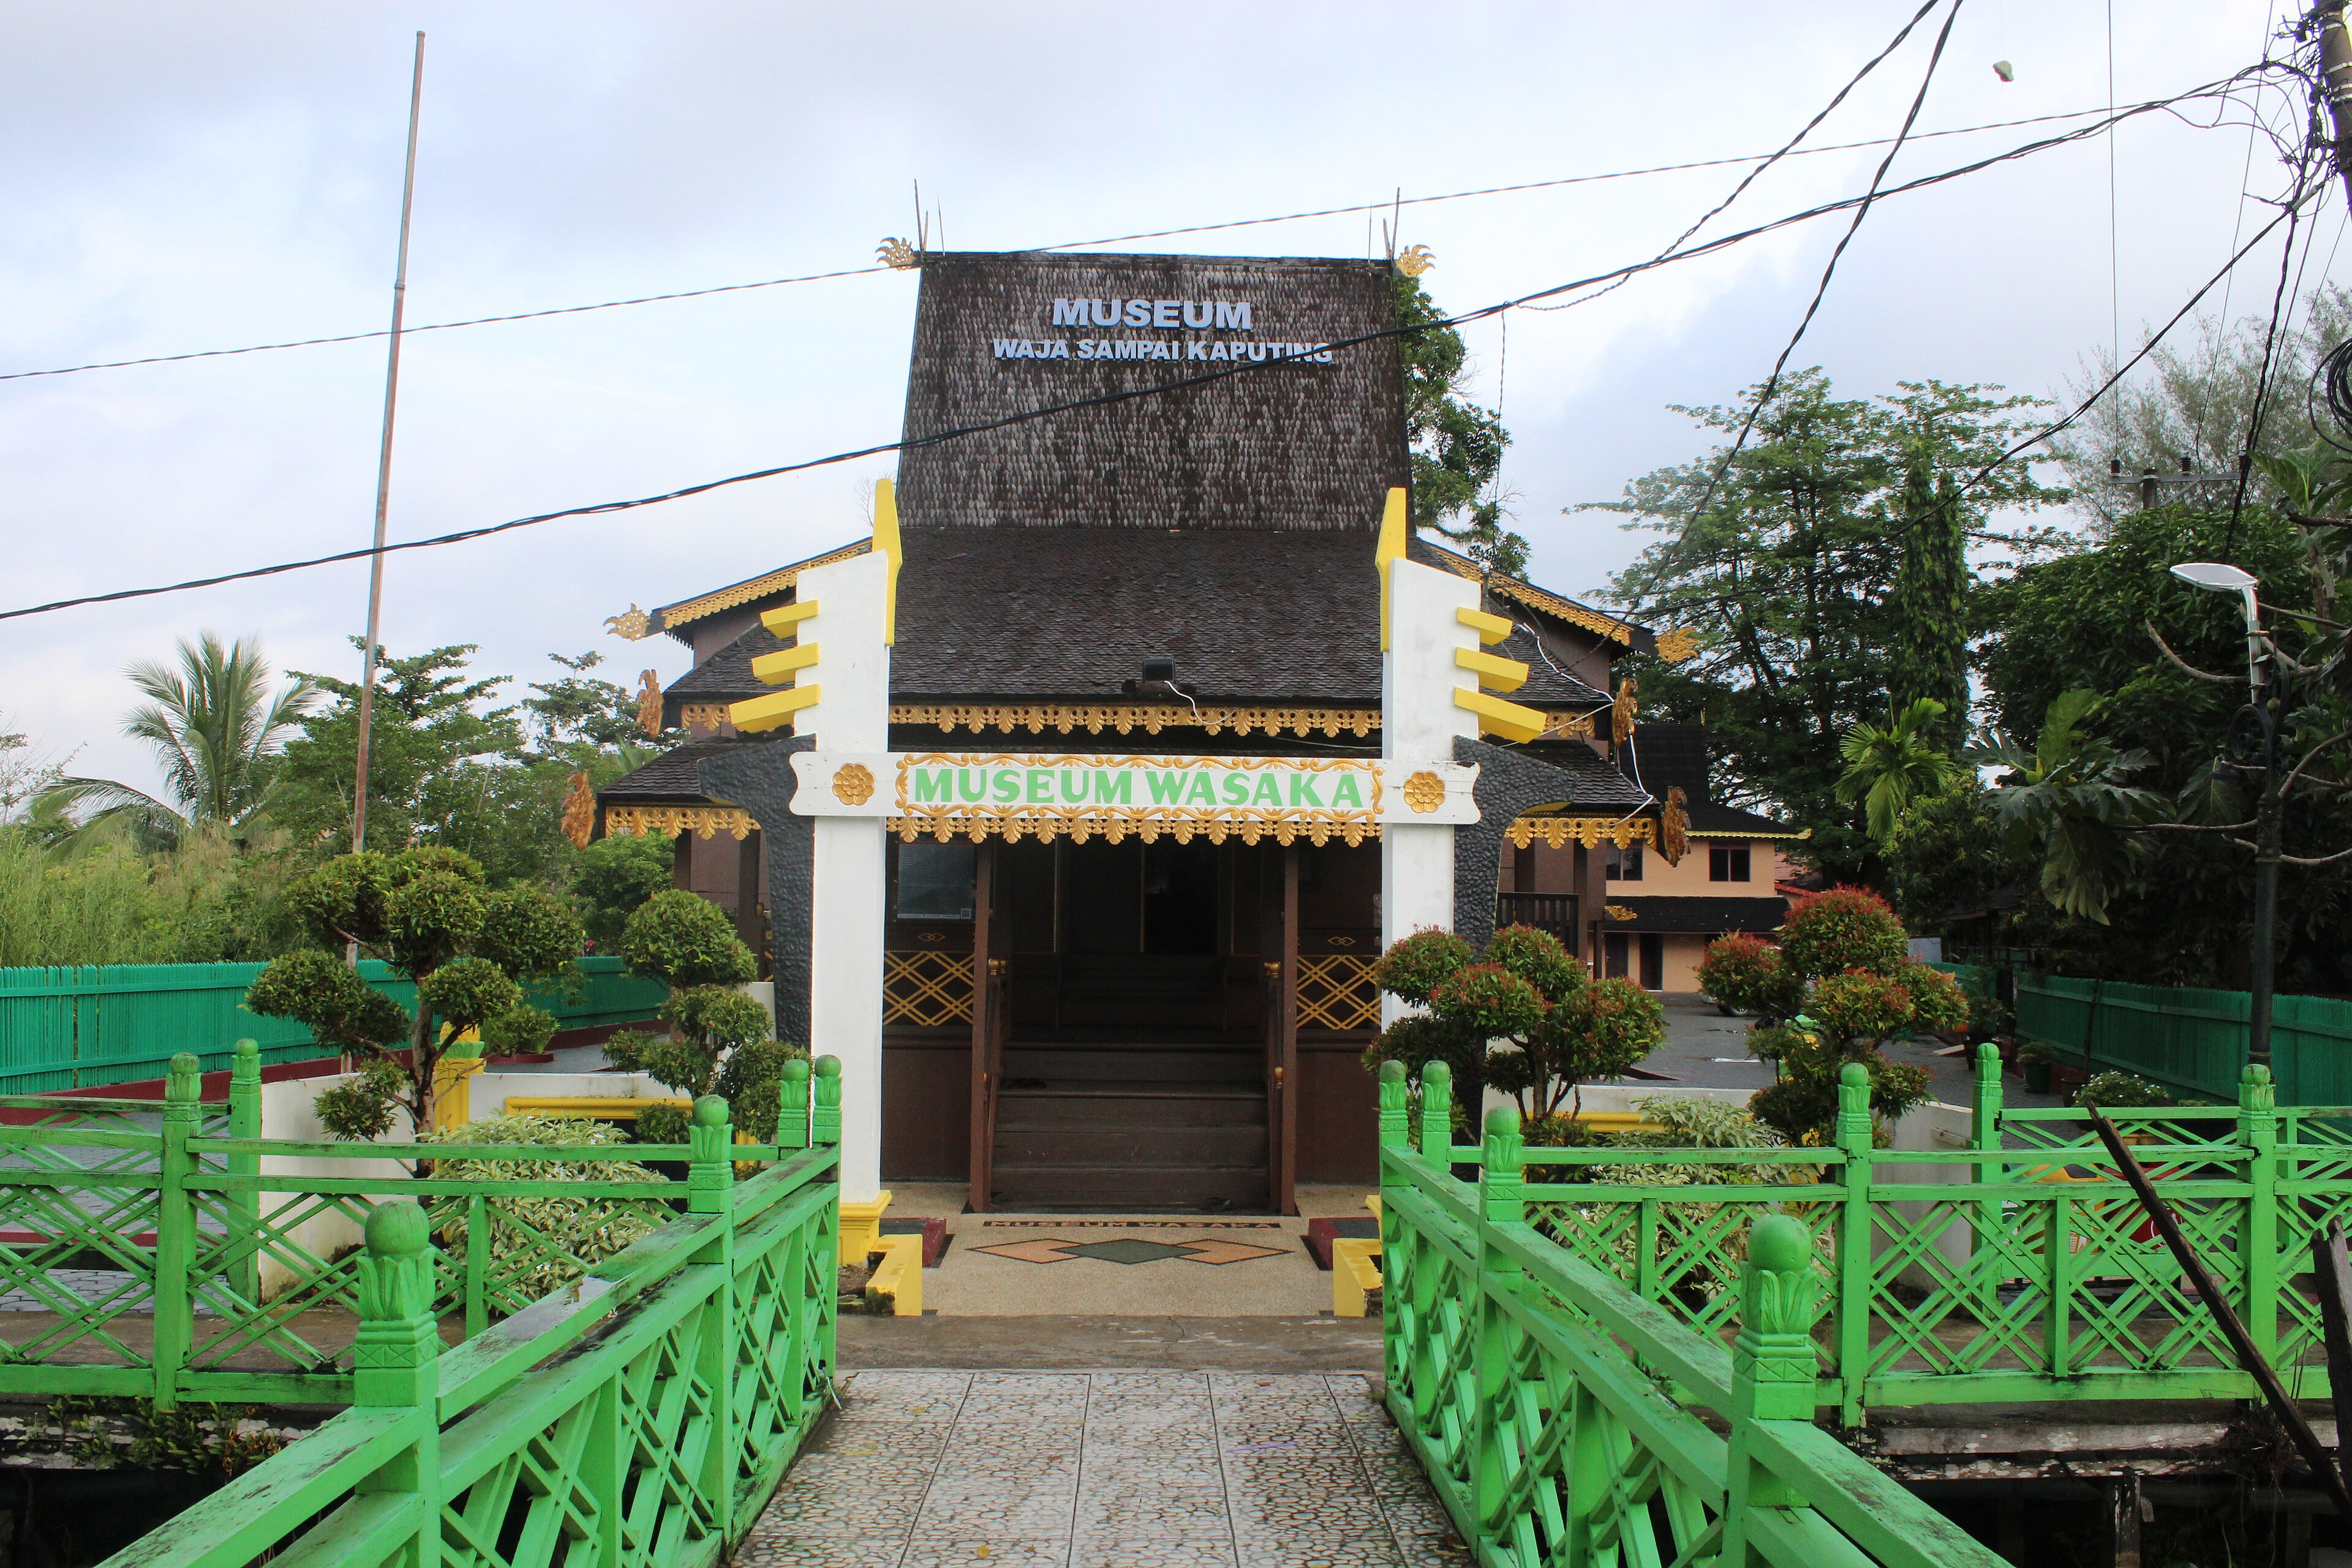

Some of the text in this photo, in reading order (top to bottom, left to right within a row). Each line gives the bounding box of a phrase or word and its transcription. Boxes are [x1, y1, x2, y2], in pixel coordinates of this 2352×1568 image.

[1052, 298, 1251, 330] MUSEUM
[993, 338, 1333, 363] WAJA SAMPAI KAPUTING
[914, 767, 1363, 807] MUSEUM WASAKA
